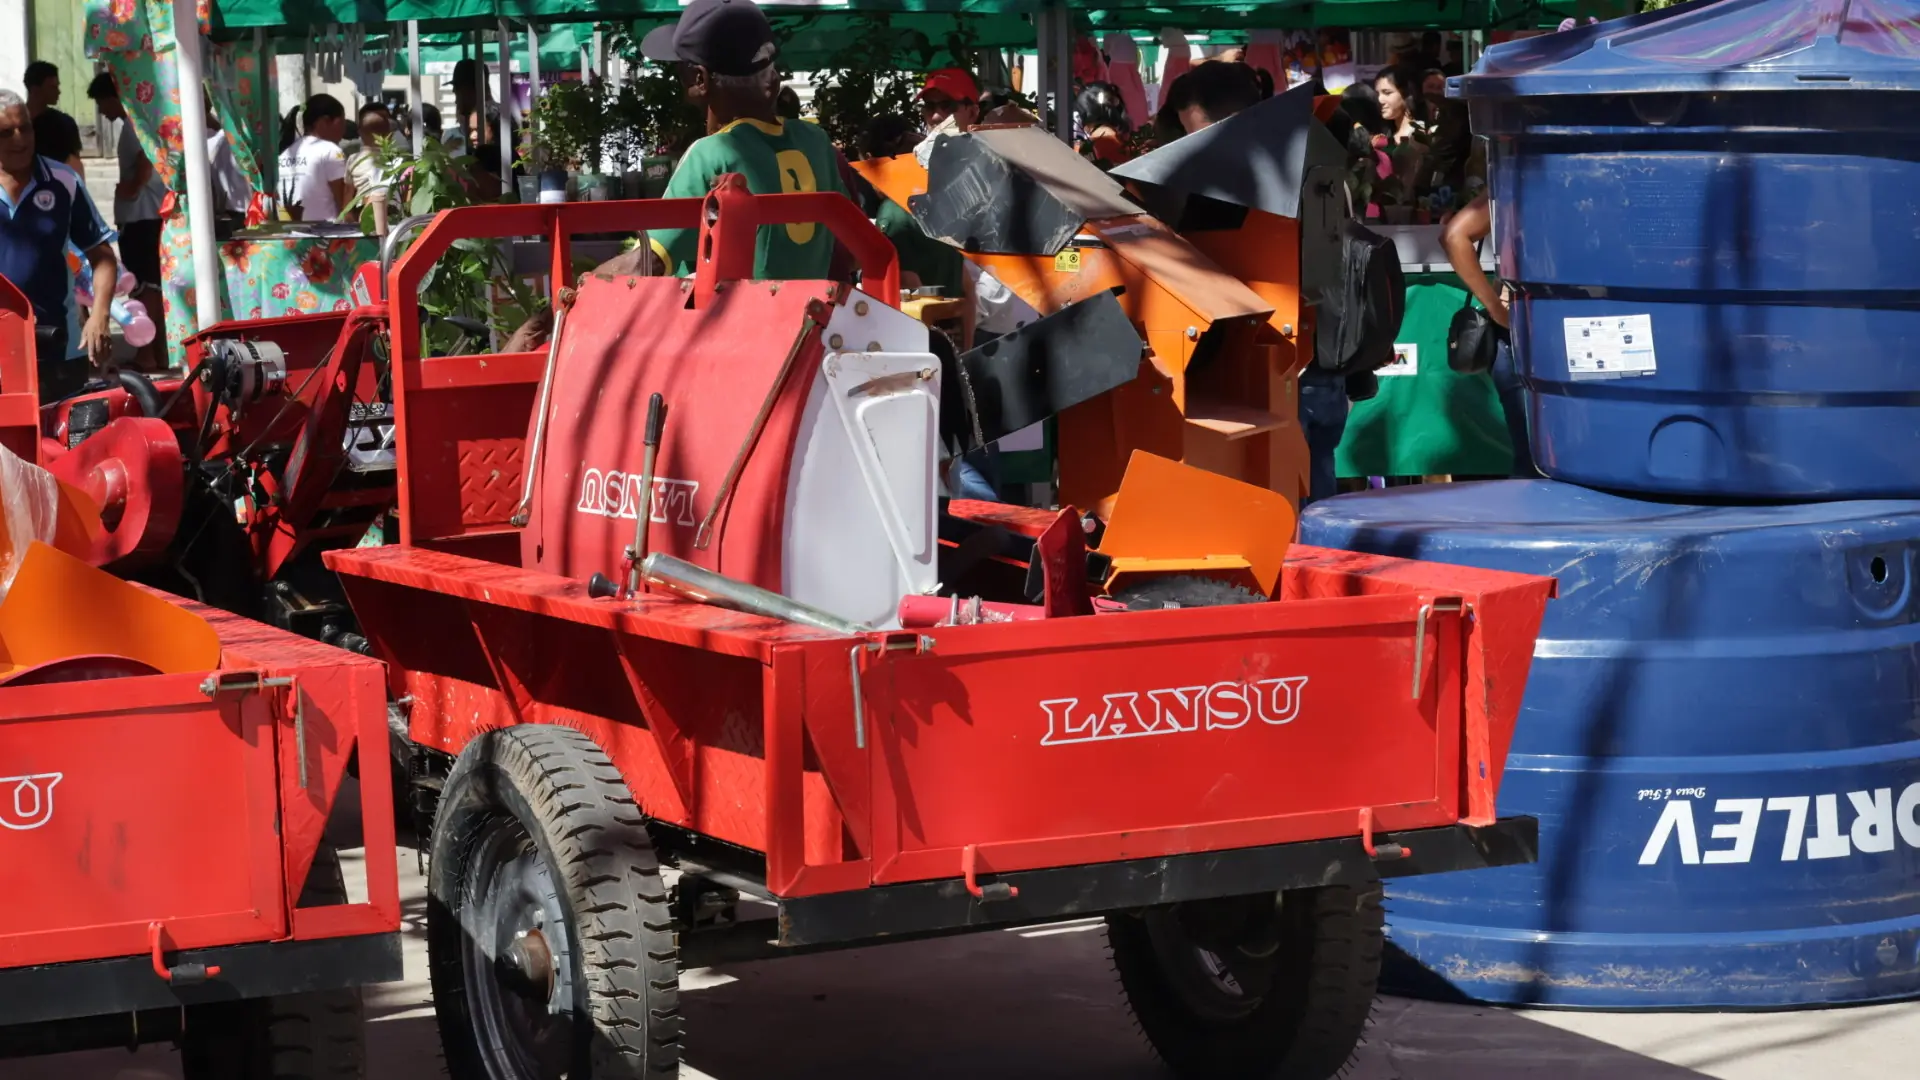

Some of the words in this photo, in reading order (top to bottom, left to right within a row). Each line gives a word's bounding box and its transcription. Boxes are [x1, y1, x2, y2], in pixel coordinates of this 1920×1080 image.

[577, 468, 699, 526] LANSU
[1039, 675, 1309, 746] LANSU
[1638, 789, 1663, 801] Fiel
[1663, 788, 1672, 800] é
[1676, 787, 1706, 799] Deus
